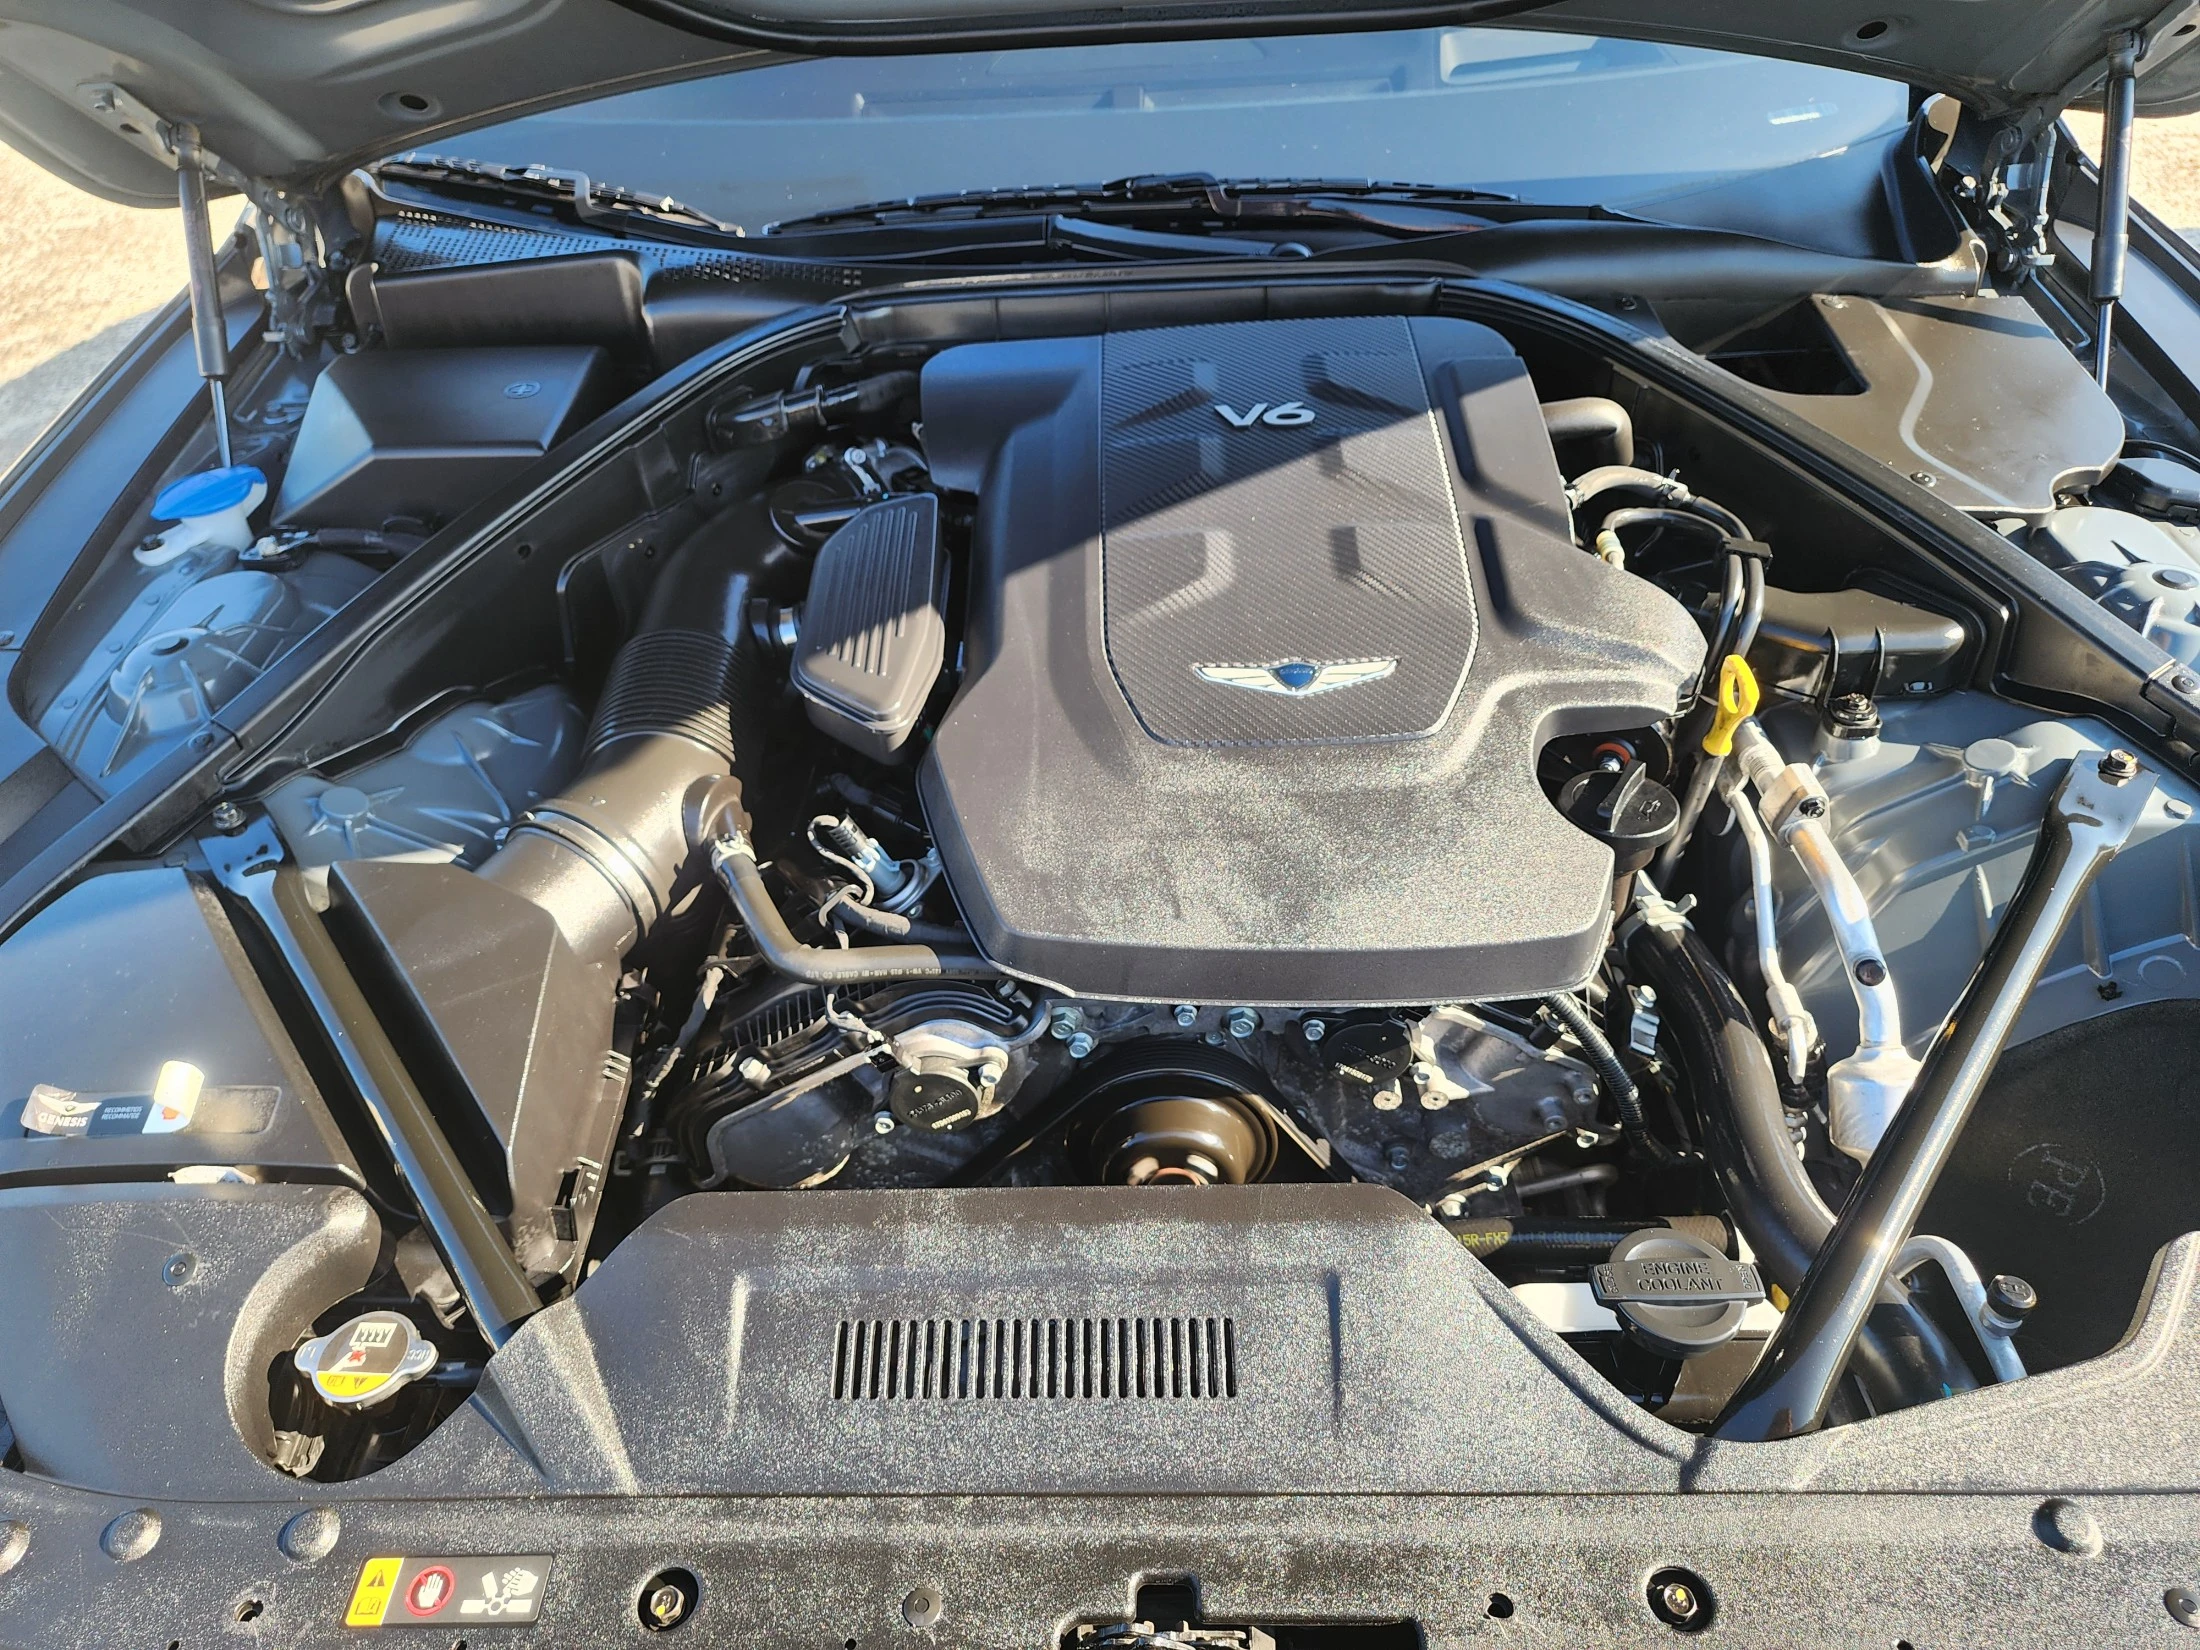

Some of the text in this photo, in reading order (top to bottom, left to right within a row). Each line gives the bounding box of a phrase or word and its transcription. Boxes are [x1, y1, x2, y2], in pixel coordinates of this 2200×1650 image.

[1214, 401, 1316, 426] V6
[38, 1112, 88, 1128] GENESIS
[1641, 1262, 1710, 1275] ENGINE
[1637, 1278, 1722, 1291] COOLANT
